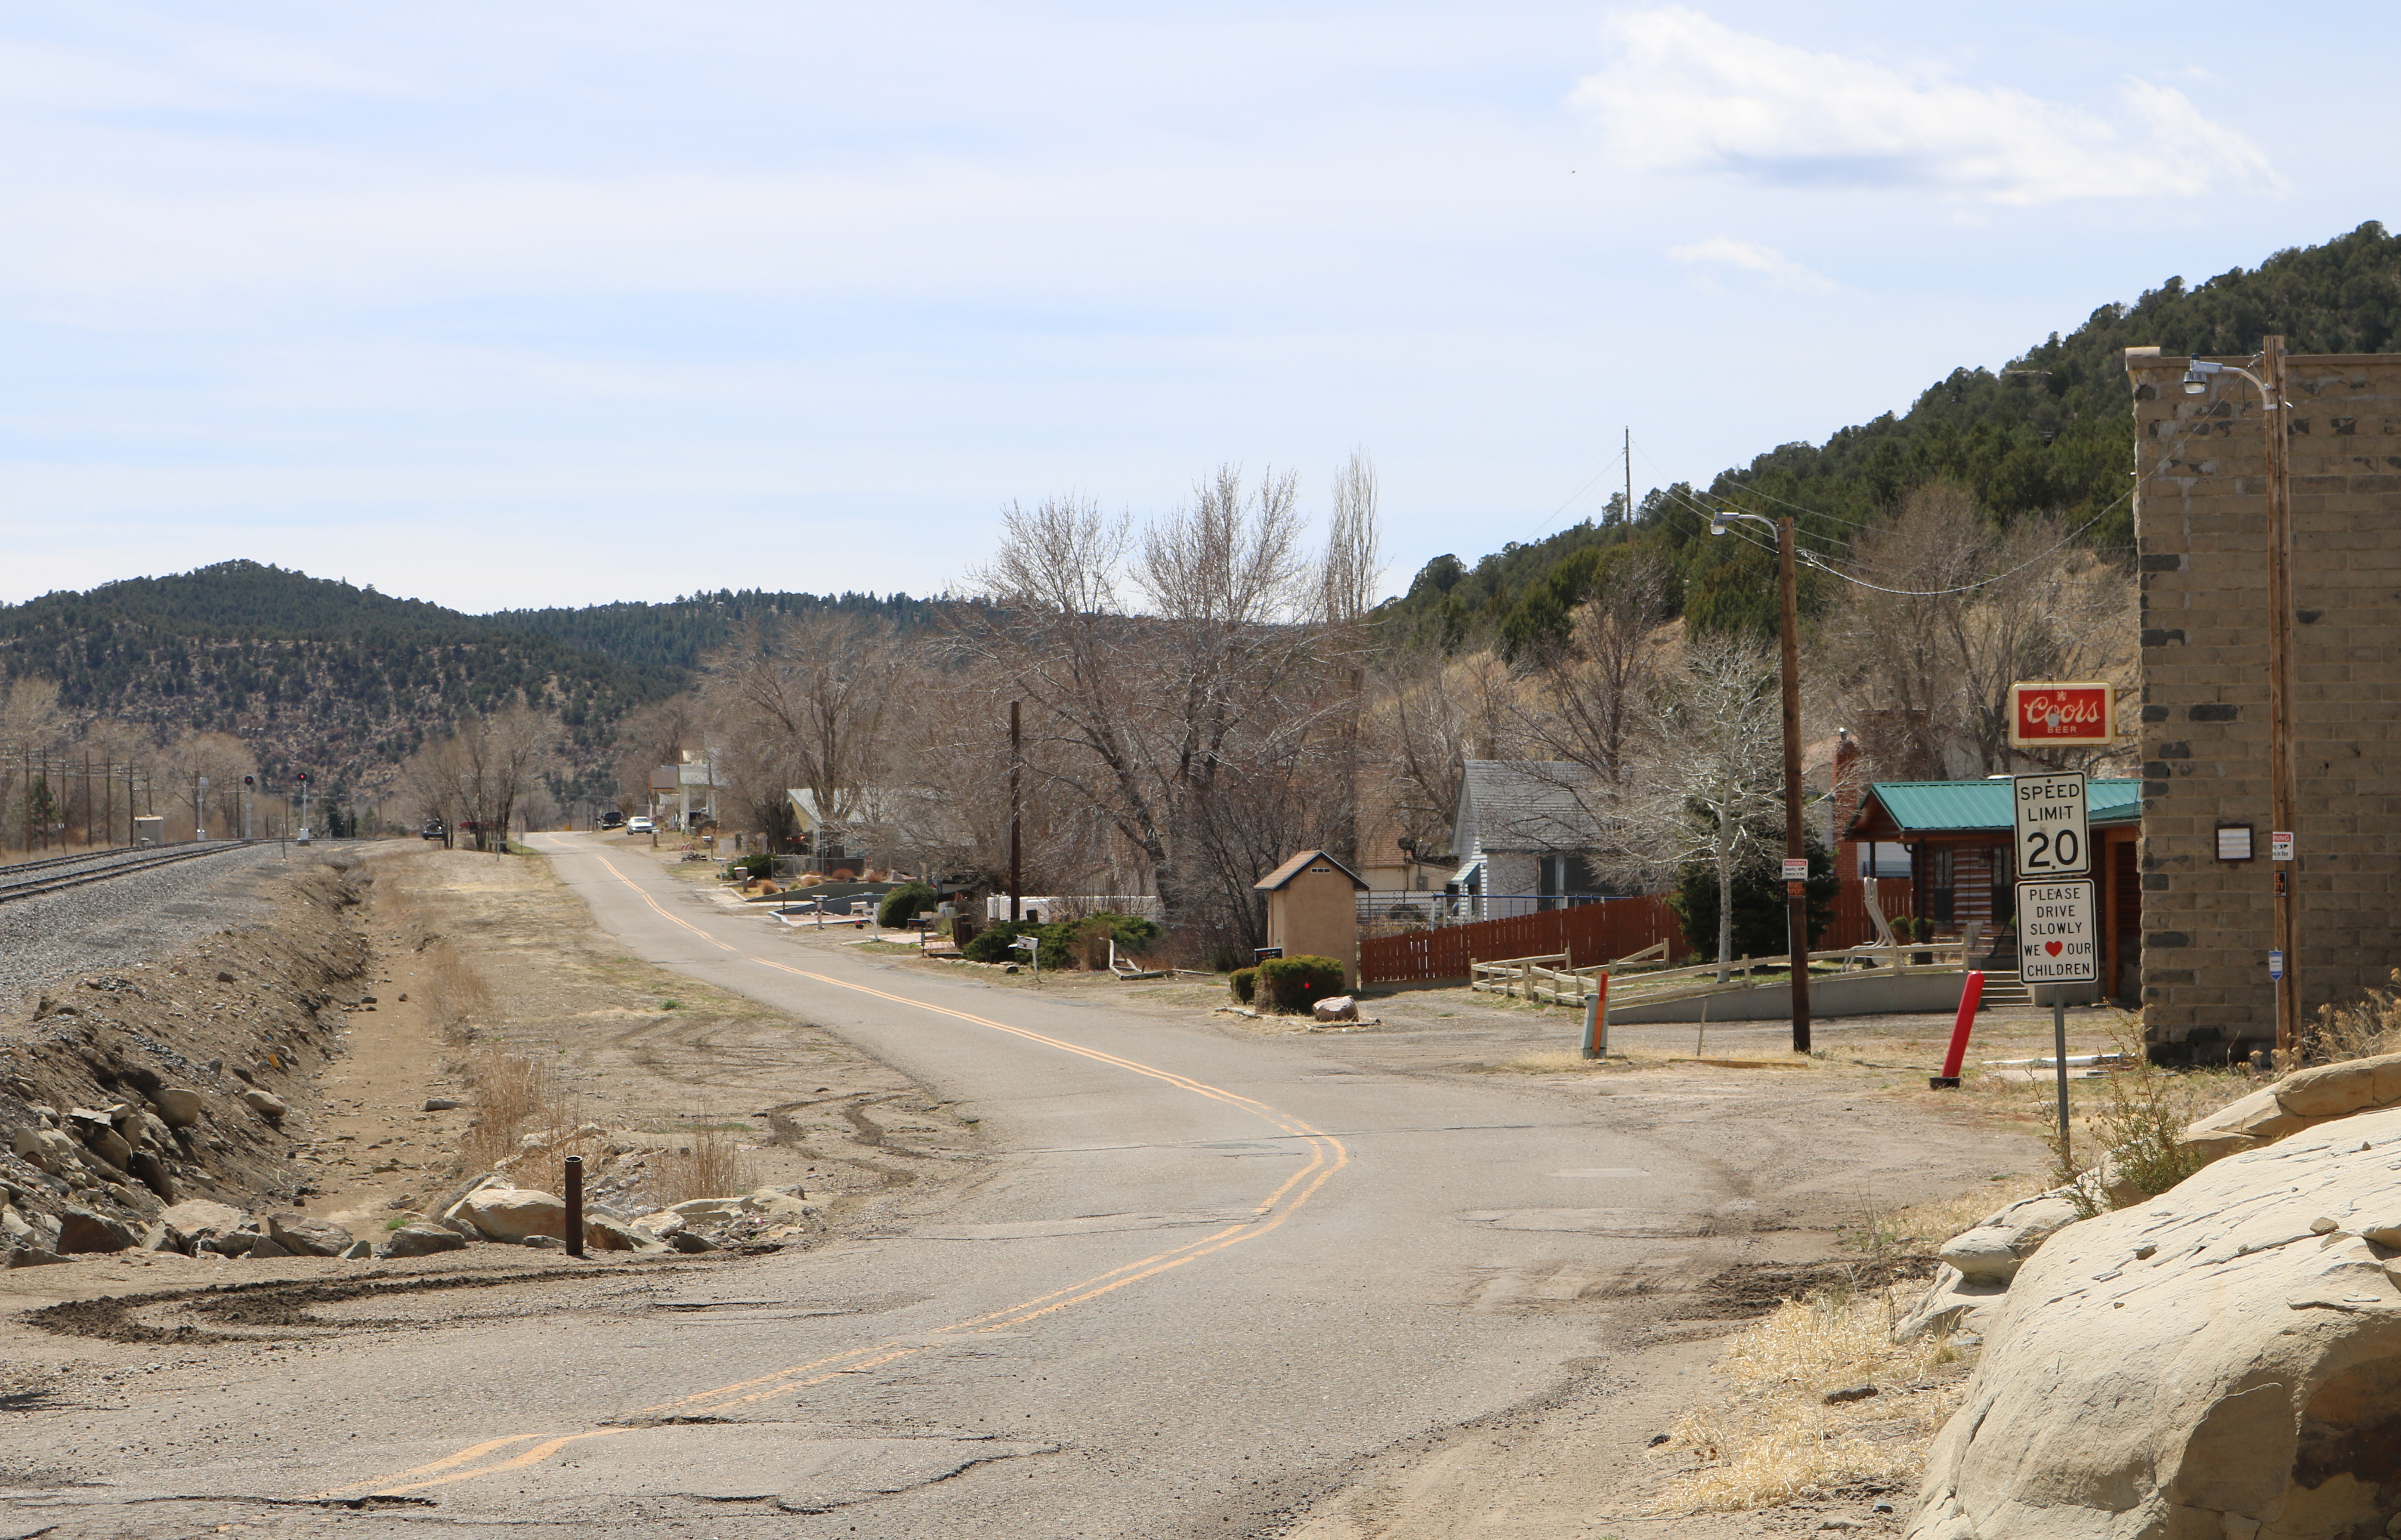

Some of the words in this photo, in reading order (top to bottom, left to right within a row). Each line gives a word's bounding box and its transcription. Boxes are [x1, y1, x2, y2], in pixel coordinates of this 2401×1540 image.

[2024, 696, 2100, 724] Coors
[2021, 784, 2080, 800] SPEED
[2028, 805, 2073, 821] LIMIT
[2027, 830, 2078, 867] 20
[2030, 888, 2080, 901] PLEASE
[2037, 905, 2075, 918] DRIVE
[2030, 922, 2082, 935] SLOWLY
[2024, 944, 2040, 956] WE
[2068, 943, 2091, 955] OUR
[2027, 963, 2090, 977] CHILDREN
